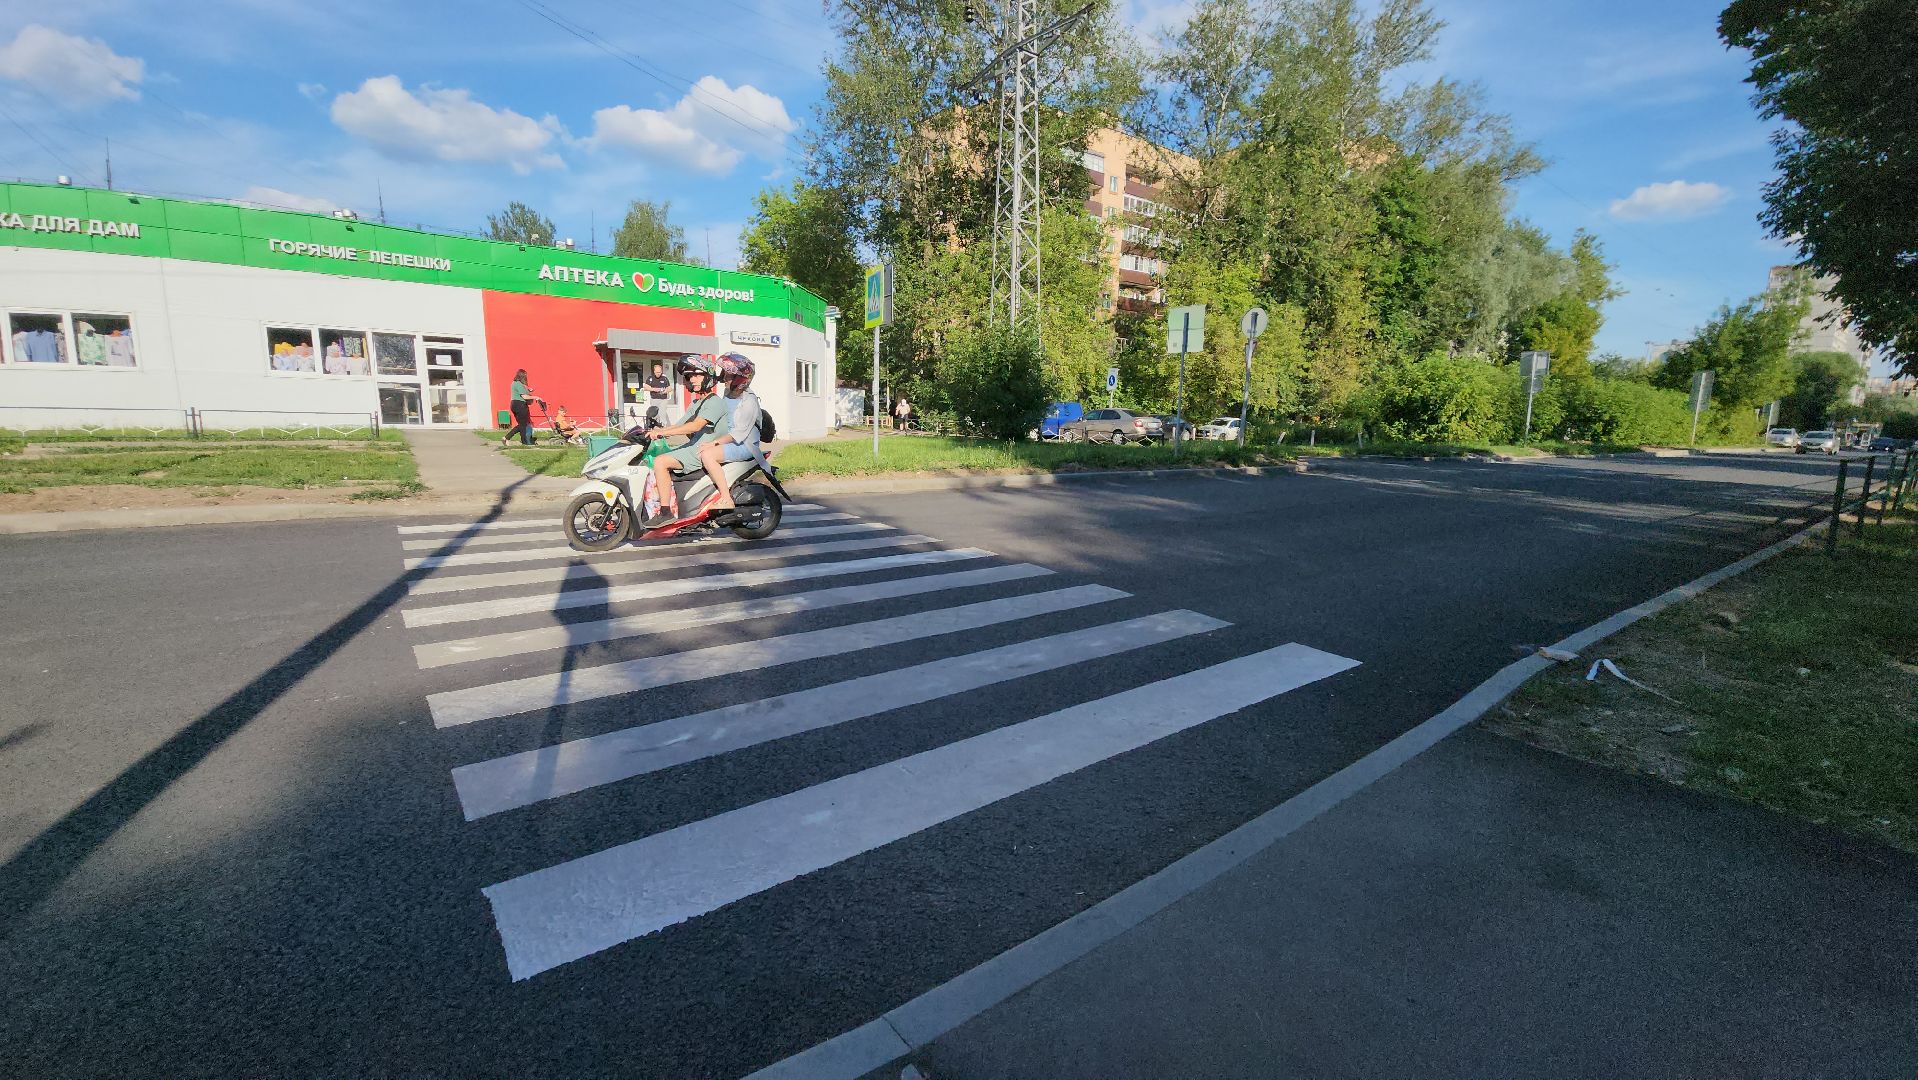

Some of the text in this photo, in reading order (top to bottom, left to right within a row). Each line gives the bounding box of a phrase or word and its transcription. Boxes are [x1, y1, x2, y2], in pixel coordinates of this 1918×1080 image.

[32, 214, 81, 233] ДЛЯ
[88, 219, 140, 238] ДАМ
[268, 238, 451, 271] ГОРЯЧИЕ ЛЕПЕШКИ
[538, 263, 755, 303] АПТЕКА Будь здоров!
